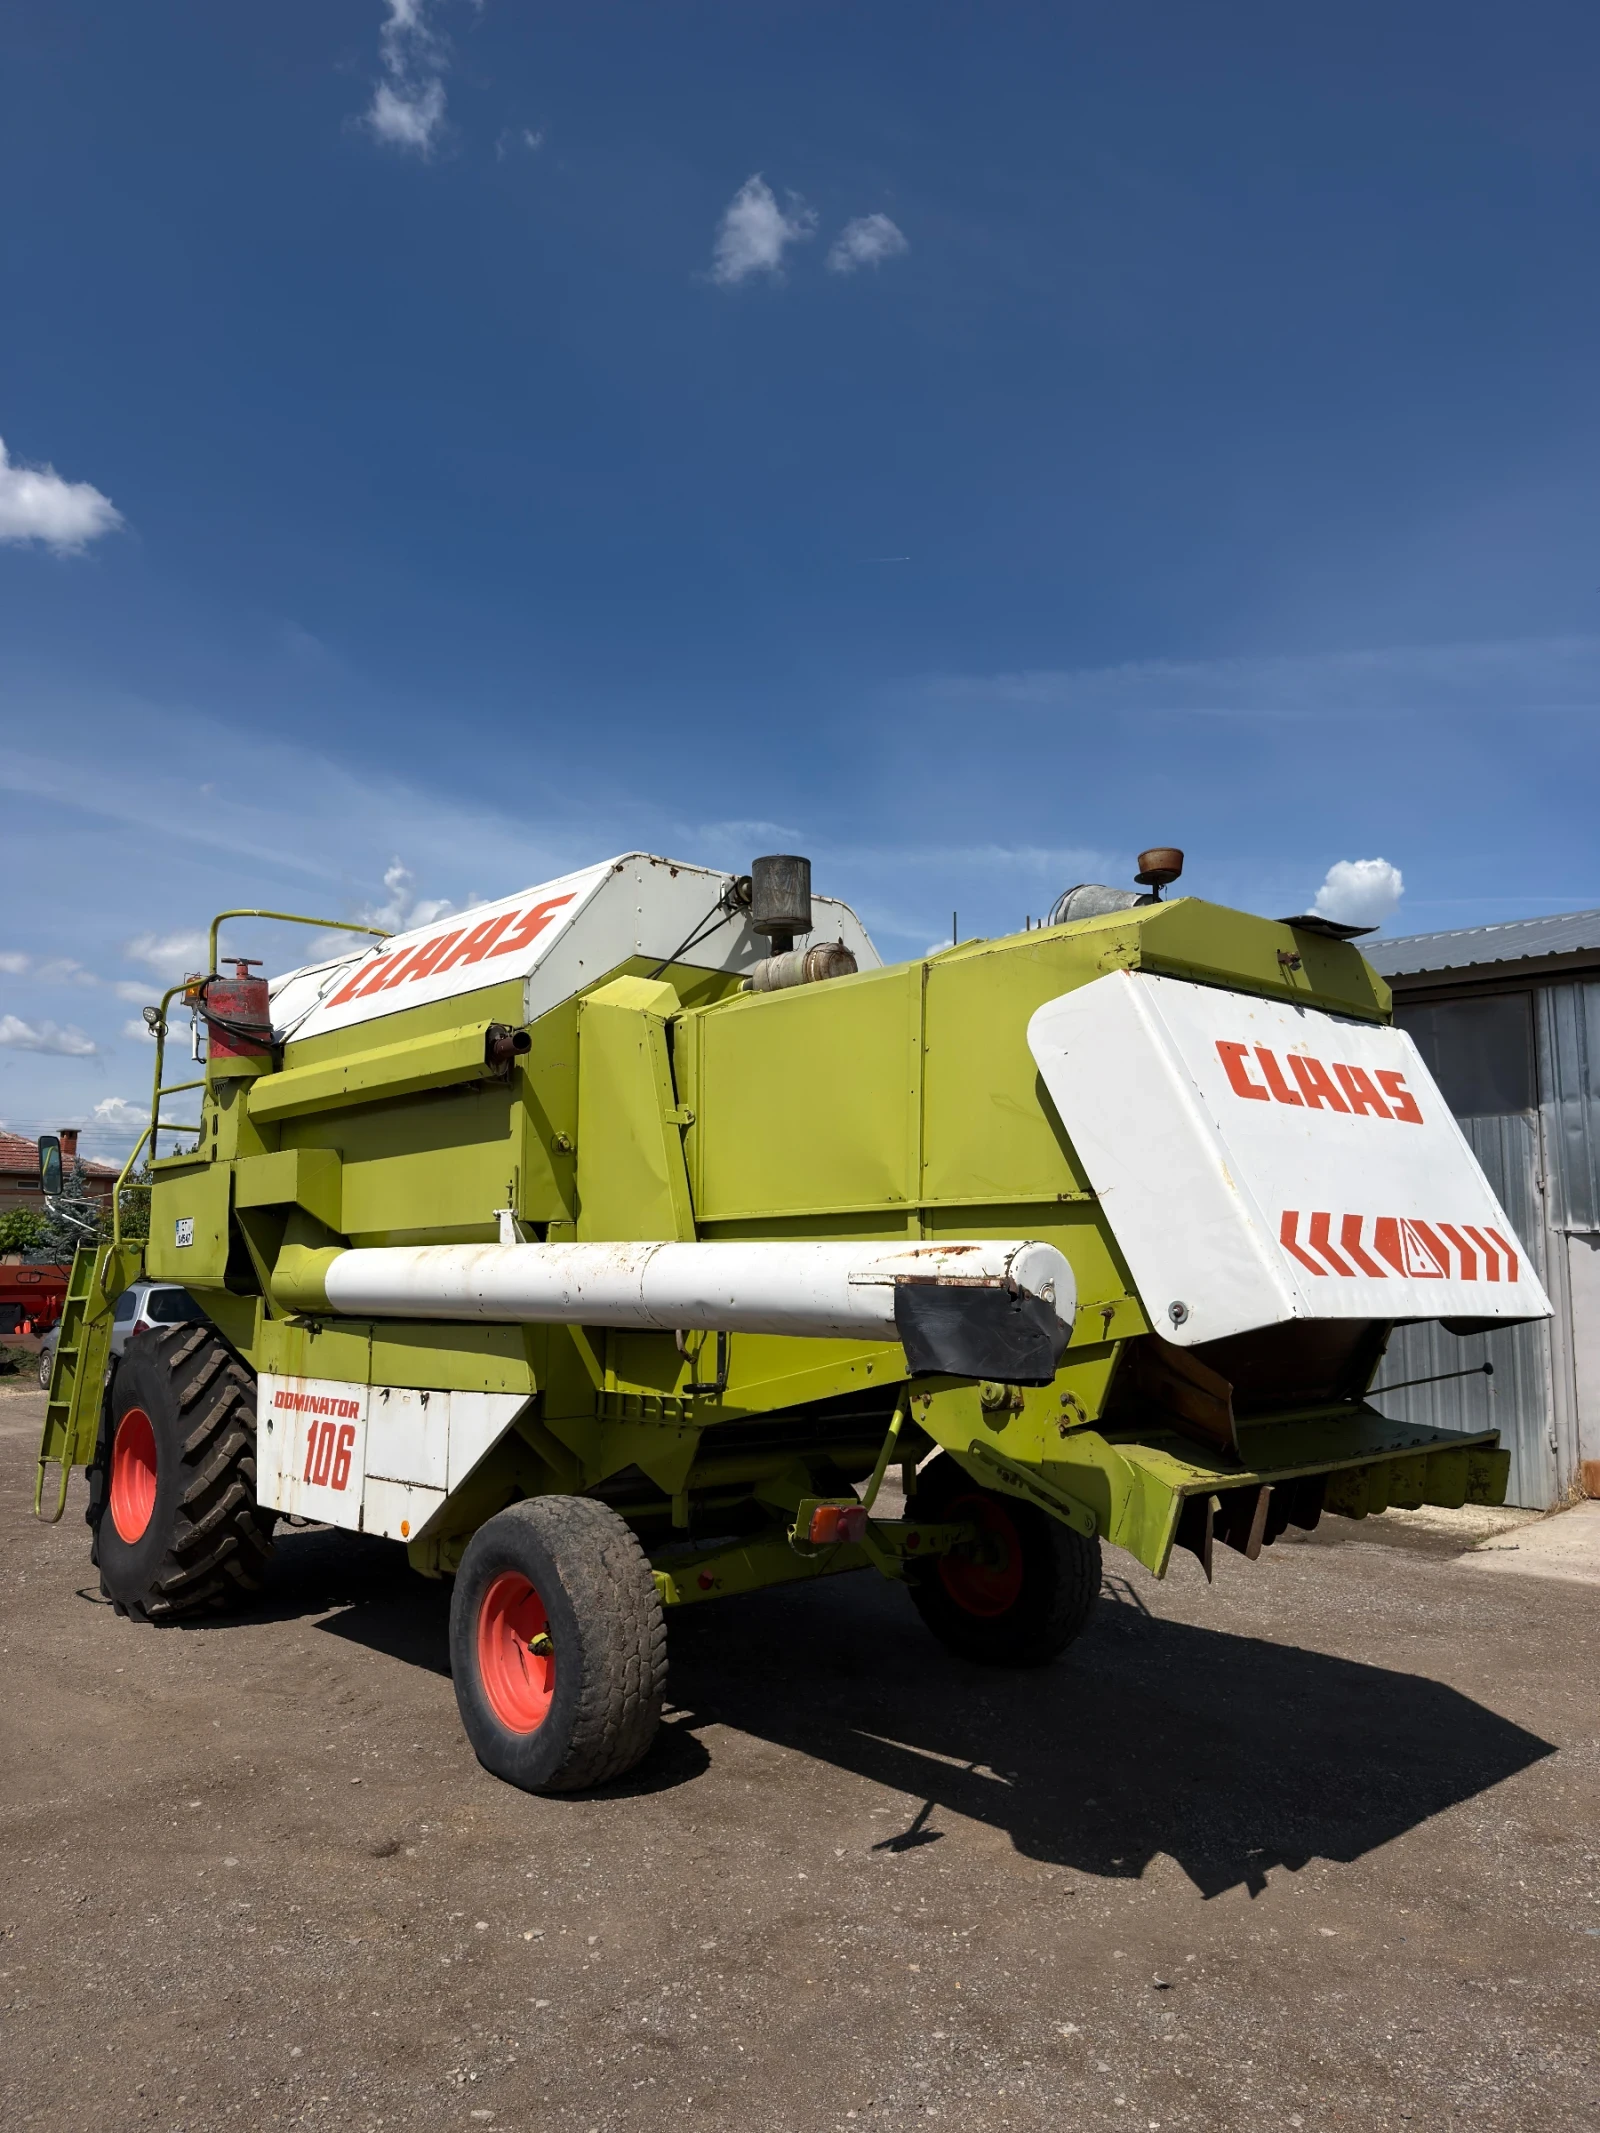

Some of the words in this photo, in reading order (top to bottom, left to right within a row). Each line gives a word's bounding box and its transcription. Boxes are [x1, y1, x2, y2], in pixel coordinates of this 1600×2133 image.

[325, 892, 578, 1009] CLAAS
[1215, 1040, 1424, 1124] CLAAS
[274, 1390, 360, 1420] DOMINATOR
[303, 1419, 356, 1491] 106
